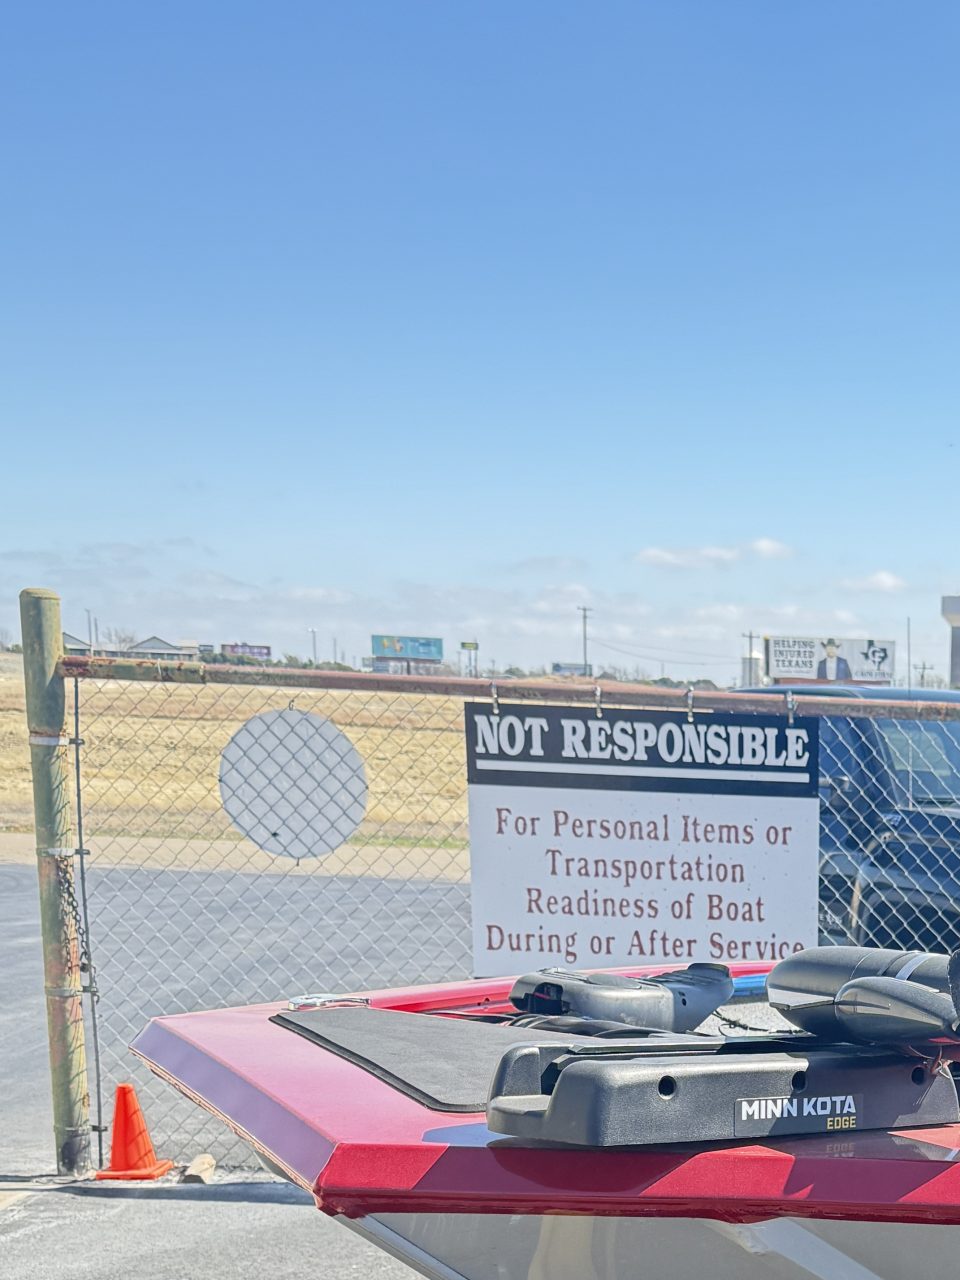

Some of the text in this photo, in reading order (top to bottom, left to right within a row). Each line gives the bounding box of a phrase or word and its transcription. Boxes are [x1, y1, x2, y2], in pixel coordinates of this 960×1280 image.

[773, 639, 816, 649] HELPING
[773, 649, 815, 659] INJURED
[775, 659, 814, 668] TEXANS
[474, 715, 810, 767] NOT RESPONSIBLE
[496, 808, 792, 845] For Personal Items or
[545, 849, 745, 888] Transportation
[526, 888, 765, 923] Readiness of Boat
[486, 924, 805, 964] During or After Service
[741, 1095, 857, 1121] MINN KOTA
[827, 1116, 857, 1130] EDGE
